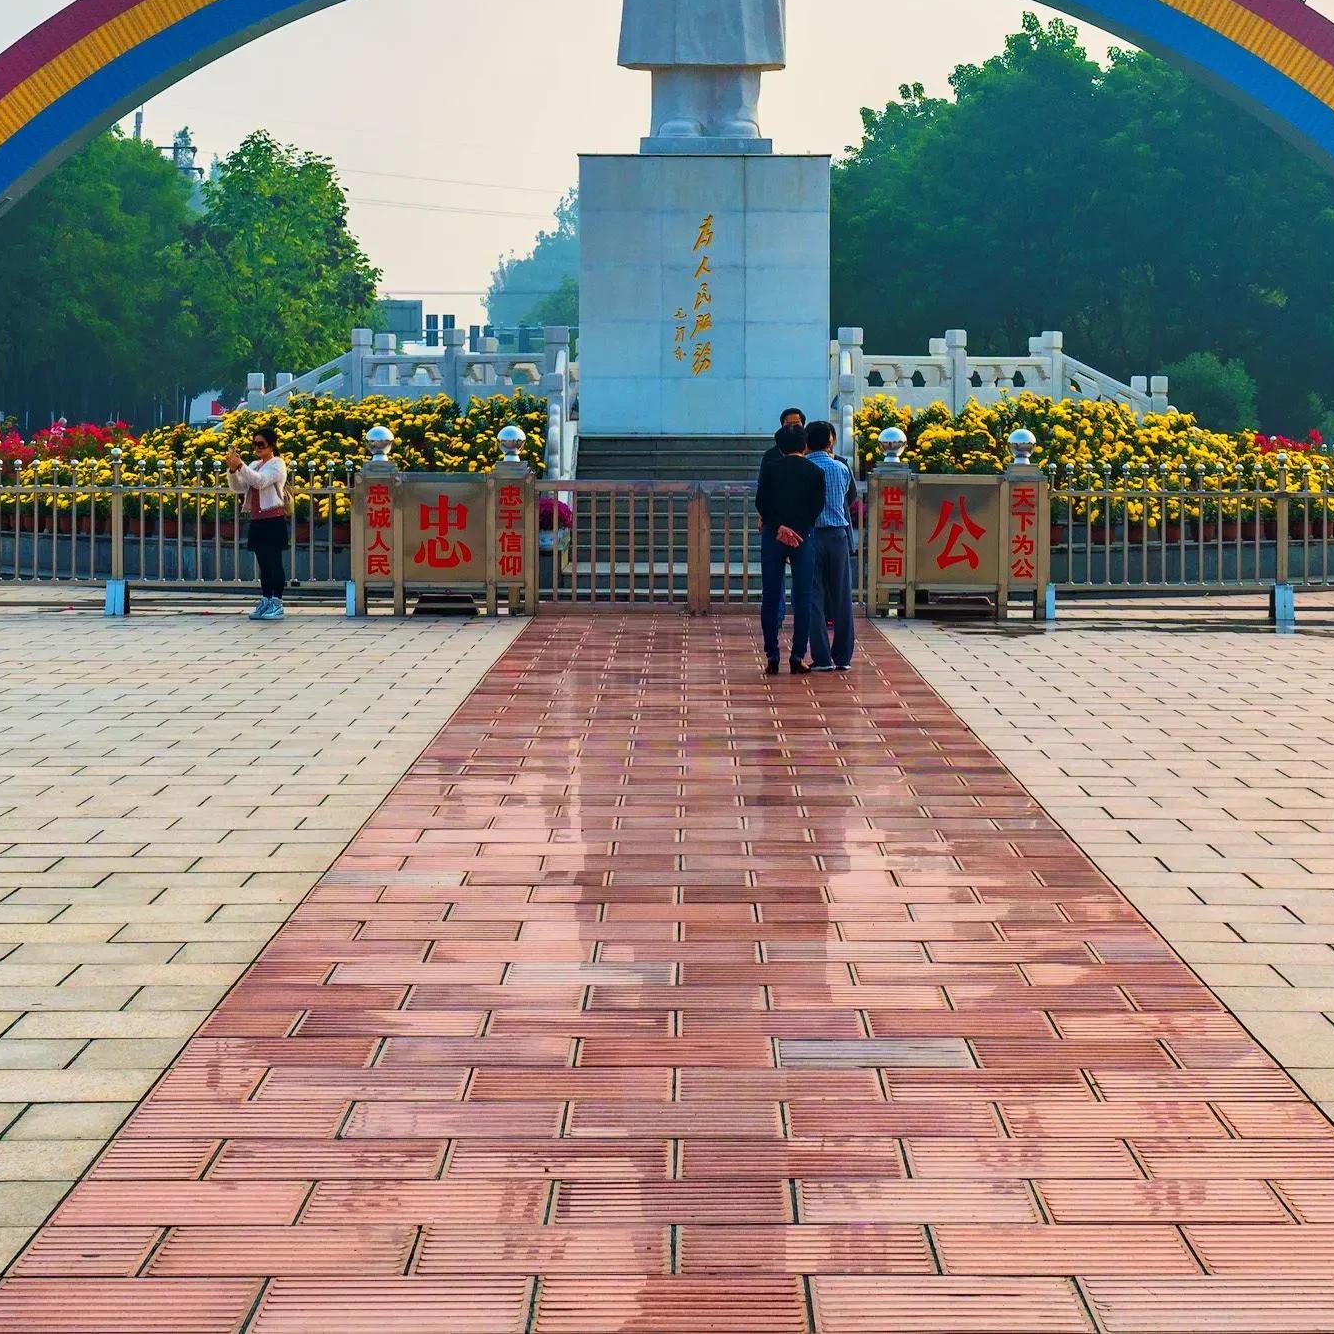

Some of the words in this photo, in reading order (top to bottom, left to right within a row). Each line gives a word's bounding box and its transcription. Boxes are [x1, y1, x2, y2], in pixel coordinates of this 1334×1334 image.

[367, 484, 391, 576] 忠诚人民
[414, 494, 472, 569] 忠
[498, 484, 523, 576] 忠于信仰
[881, 486, 905, 577] 世界大同
[927, 496, 986, 570] 公
[1011, 488, 1035, 579] 天下为公
